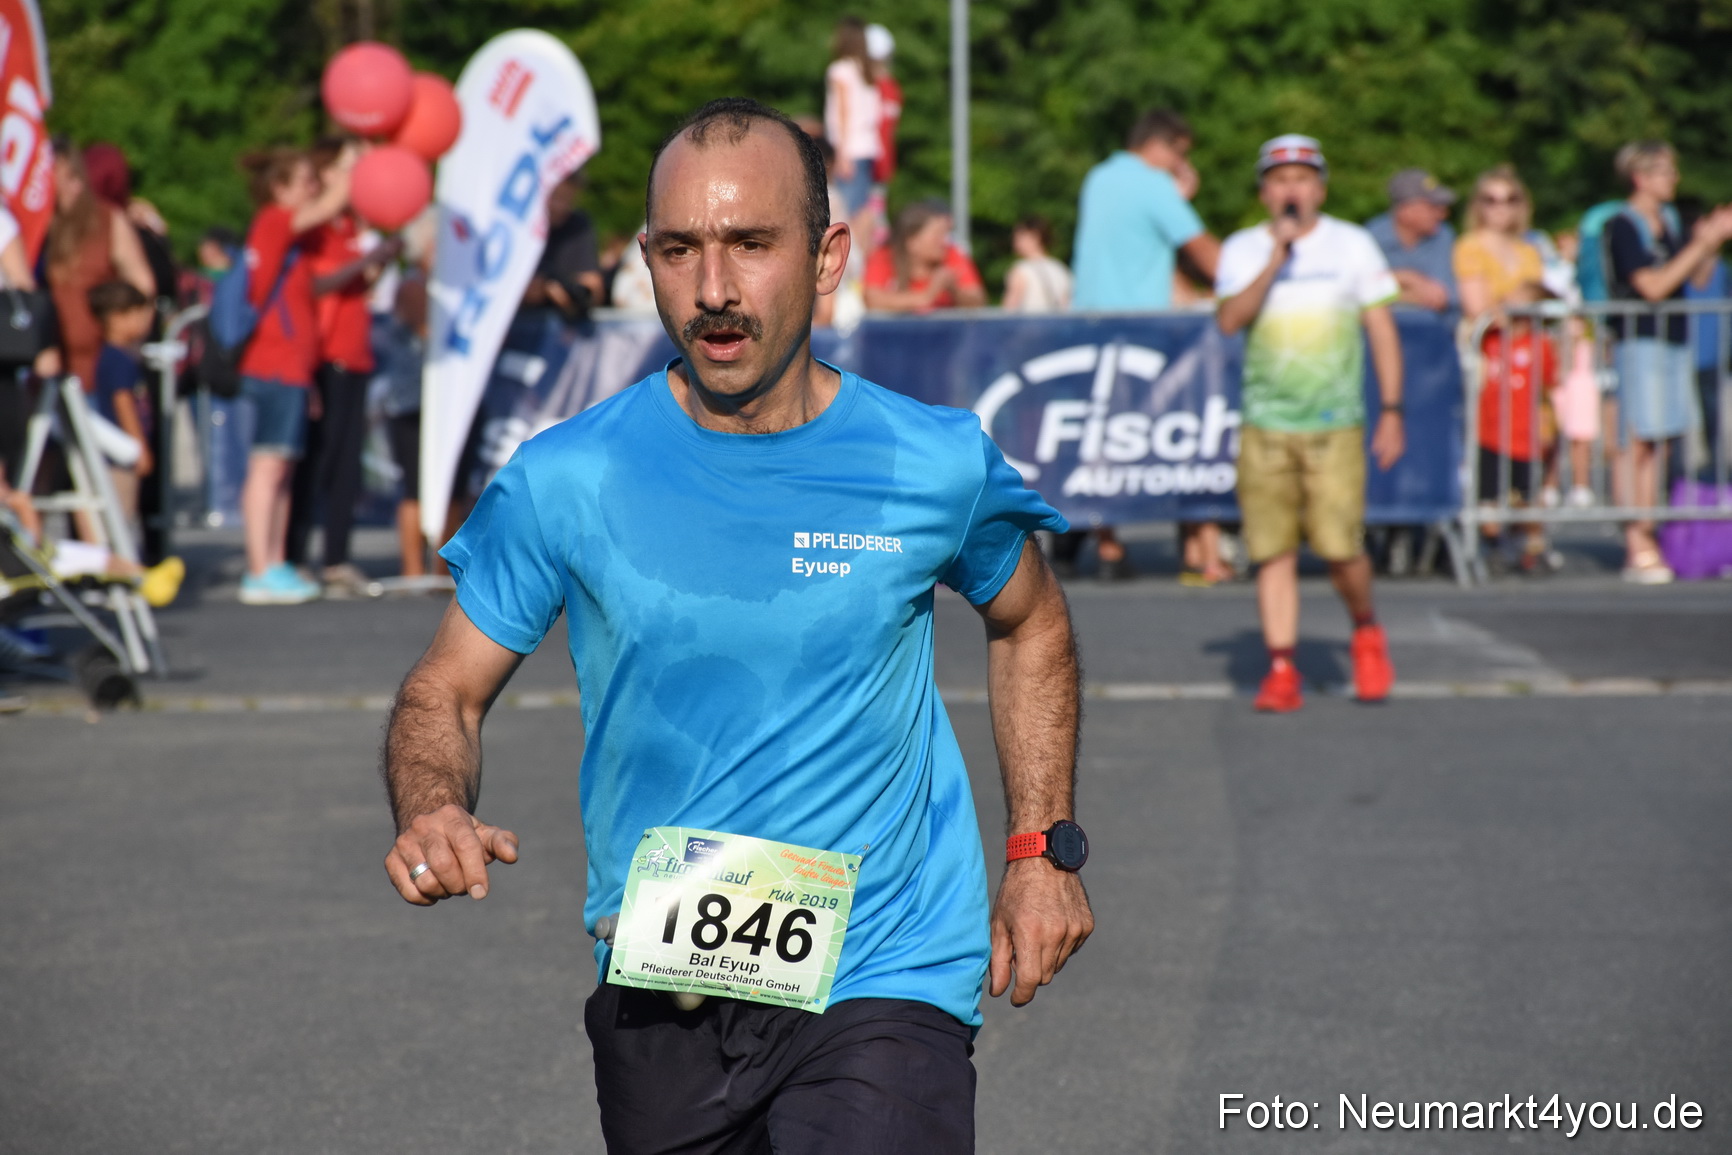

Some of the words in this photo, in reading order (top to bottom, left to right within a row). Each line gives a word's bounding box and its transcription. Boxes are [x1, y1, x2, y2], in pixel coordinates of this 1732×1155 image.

[1034, 394, 1242, 463] Fisch
[812, 532, 903, 553] PFLEIDERER
[792, 557, 851, 577] Eyuep
[780, 849, 817, 867] Gesunde
[799, 893, 839, 910] 2019
[654, 889, 817, 963] 1846
[689, 952, 715, 967] Bal
[719, 956, 760, 975] Eyup
[641, 962, 693, 977] Pfleiderer
[695, 969, 763, 986] Deutschland
[766, 979, 801, 993] GmbH
